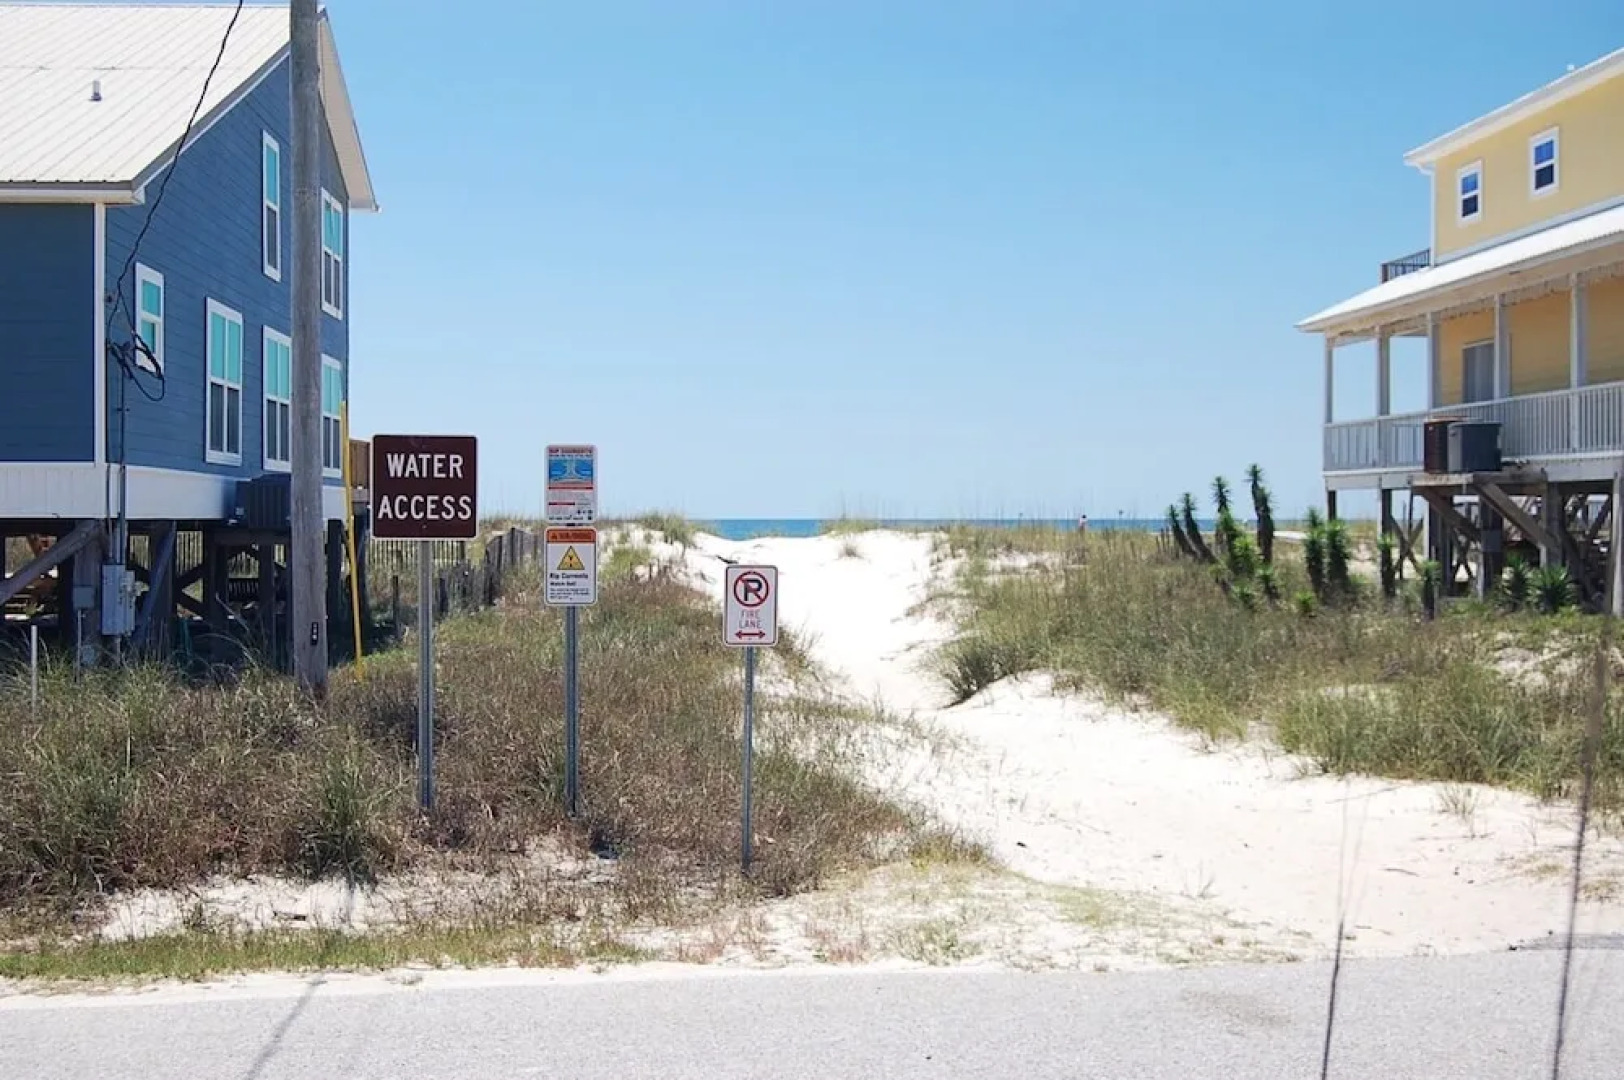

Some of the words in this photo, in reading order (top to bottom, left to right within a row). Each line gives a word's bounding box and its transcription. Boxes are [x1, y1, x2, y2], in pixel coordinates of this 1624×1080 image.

[387, 453, 463, 478] WATER
[377, 495, 471, 519] ACCESS
[740, 609, 761, 619] FIRE
[739, 619, 762, 629] LANE
